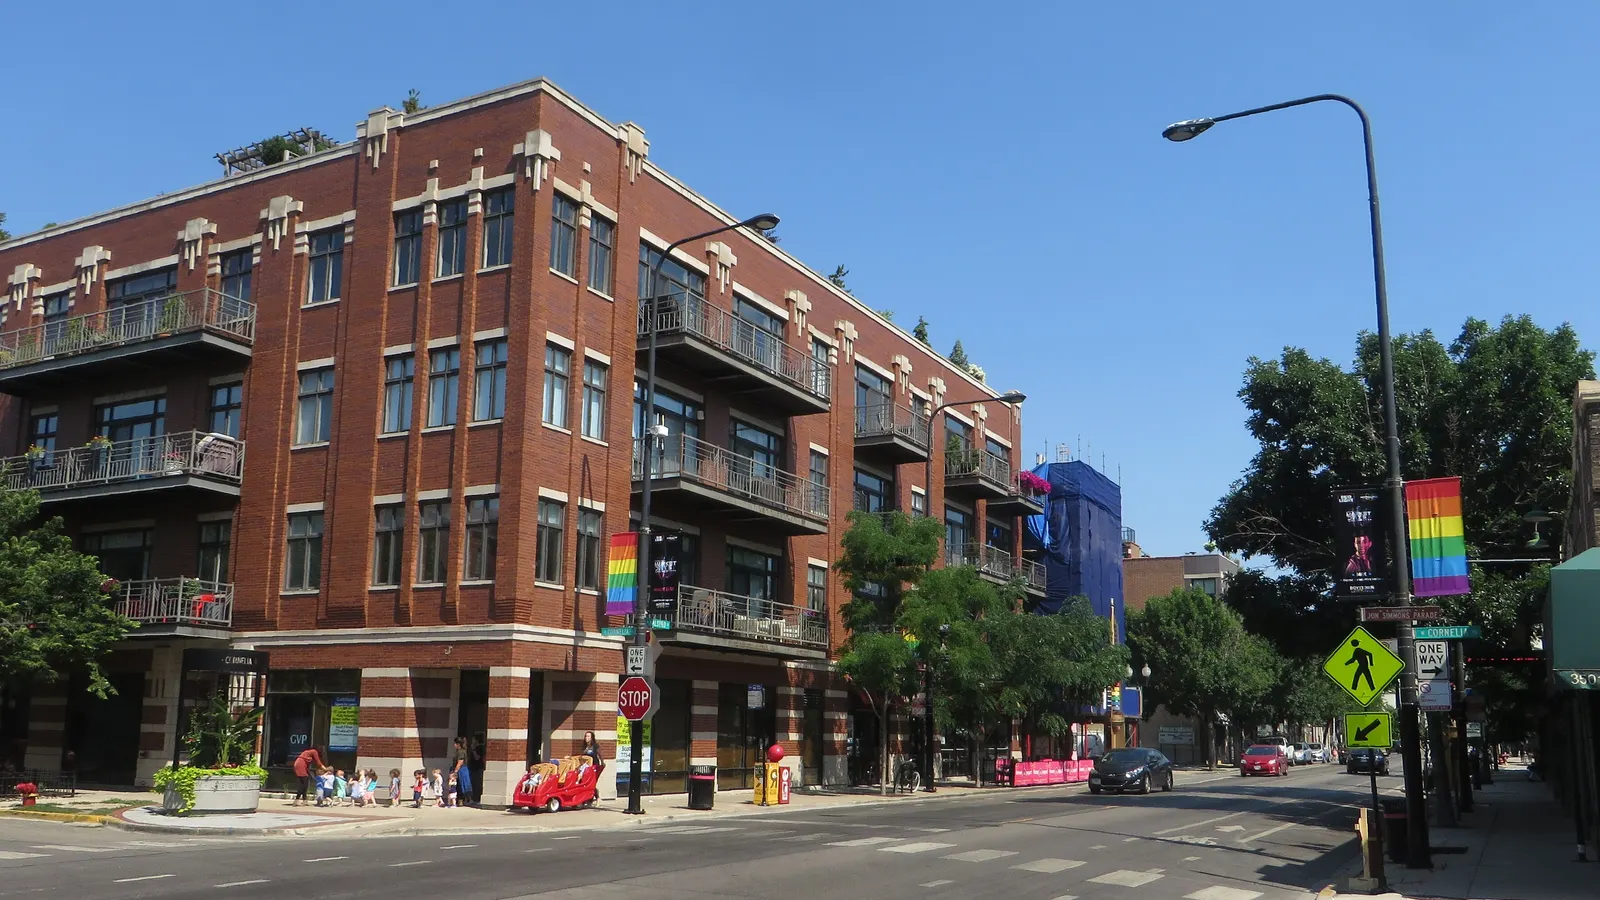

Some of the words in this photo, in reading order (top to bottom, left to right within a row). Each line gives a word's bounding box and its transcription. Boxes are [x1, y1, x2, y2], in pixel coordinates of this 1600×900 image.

[1382, 611, 1411, 619] SIMMONS
[1413, 611, 1439, 619] PARADE
[1427, 627, 1469, 638] CORNELIA
[1419, 644, 1444, 654] ONE
[629, 656, 644, 664] WAY
[1419, 655, 1444, 665] WAY
[1570, 673, 1600, 685] 350
[620, 690, 649, 707] STOP
[290, 734, 308, 745] GVP
